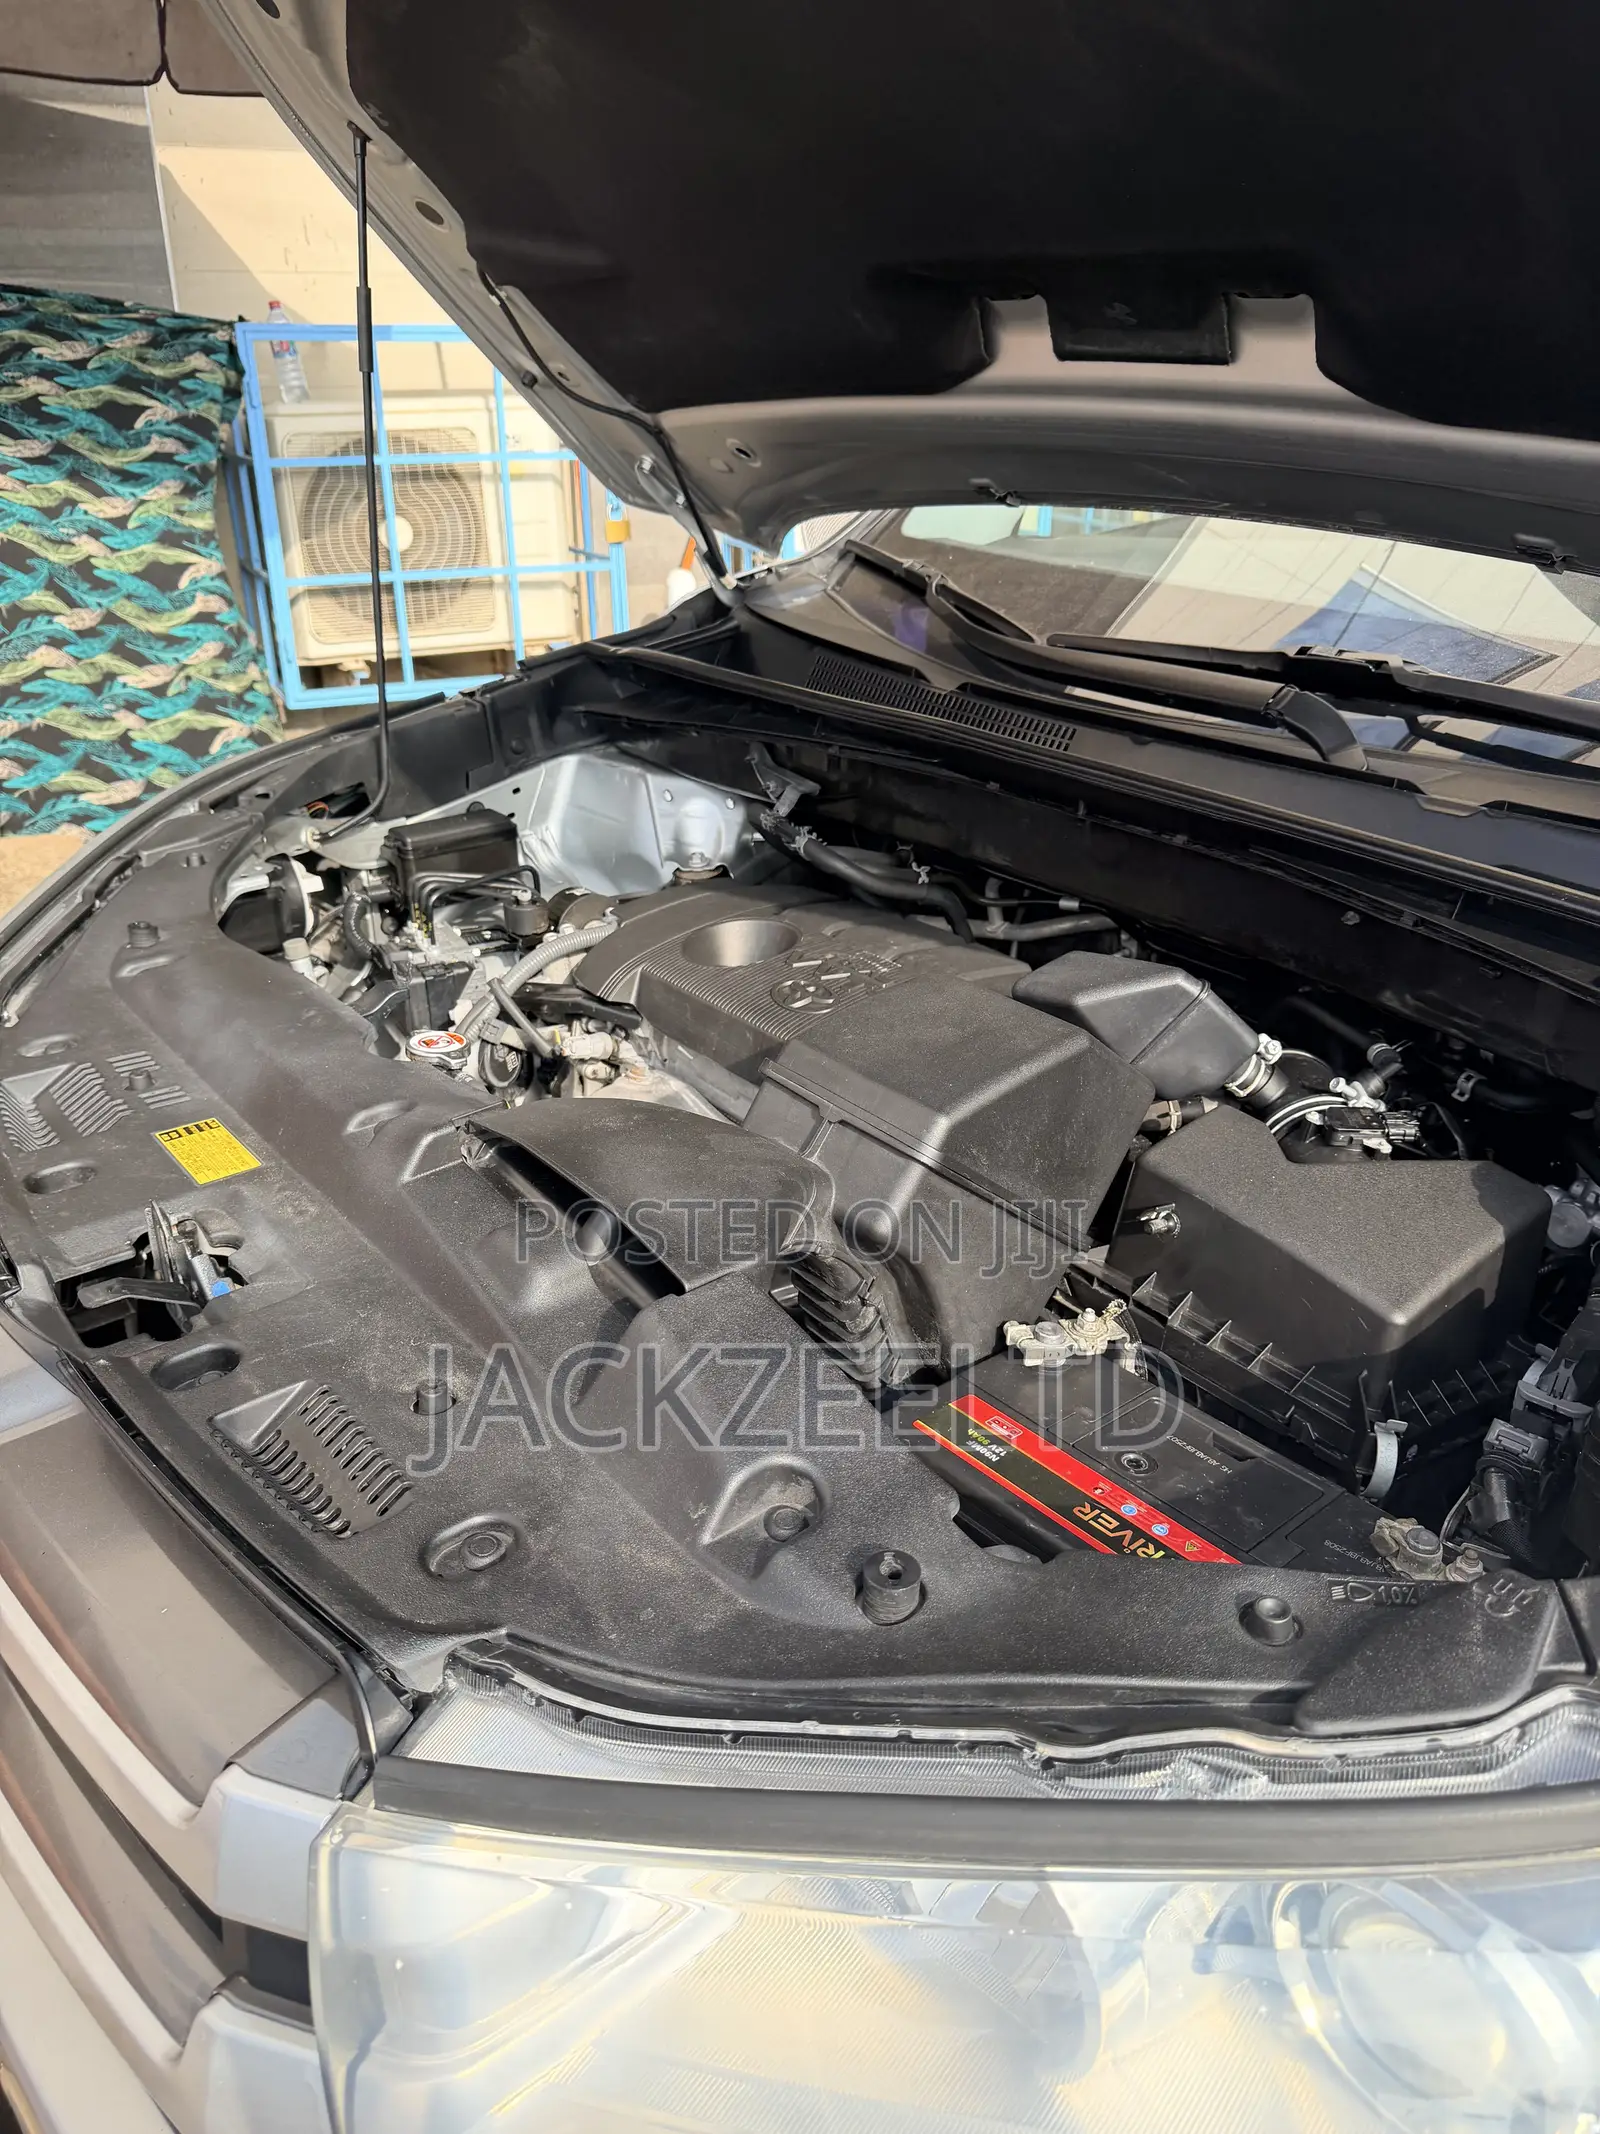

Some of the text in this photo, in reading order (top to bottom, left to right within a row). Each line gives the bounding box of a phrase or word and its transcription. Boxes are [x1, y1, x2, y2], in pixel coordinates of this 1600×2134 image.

[967, 1428, 991, 1446] 90Ah
[965, 1440, 1000, 1462] N90MF
[988, 1444, 1007, 1457] 12V
